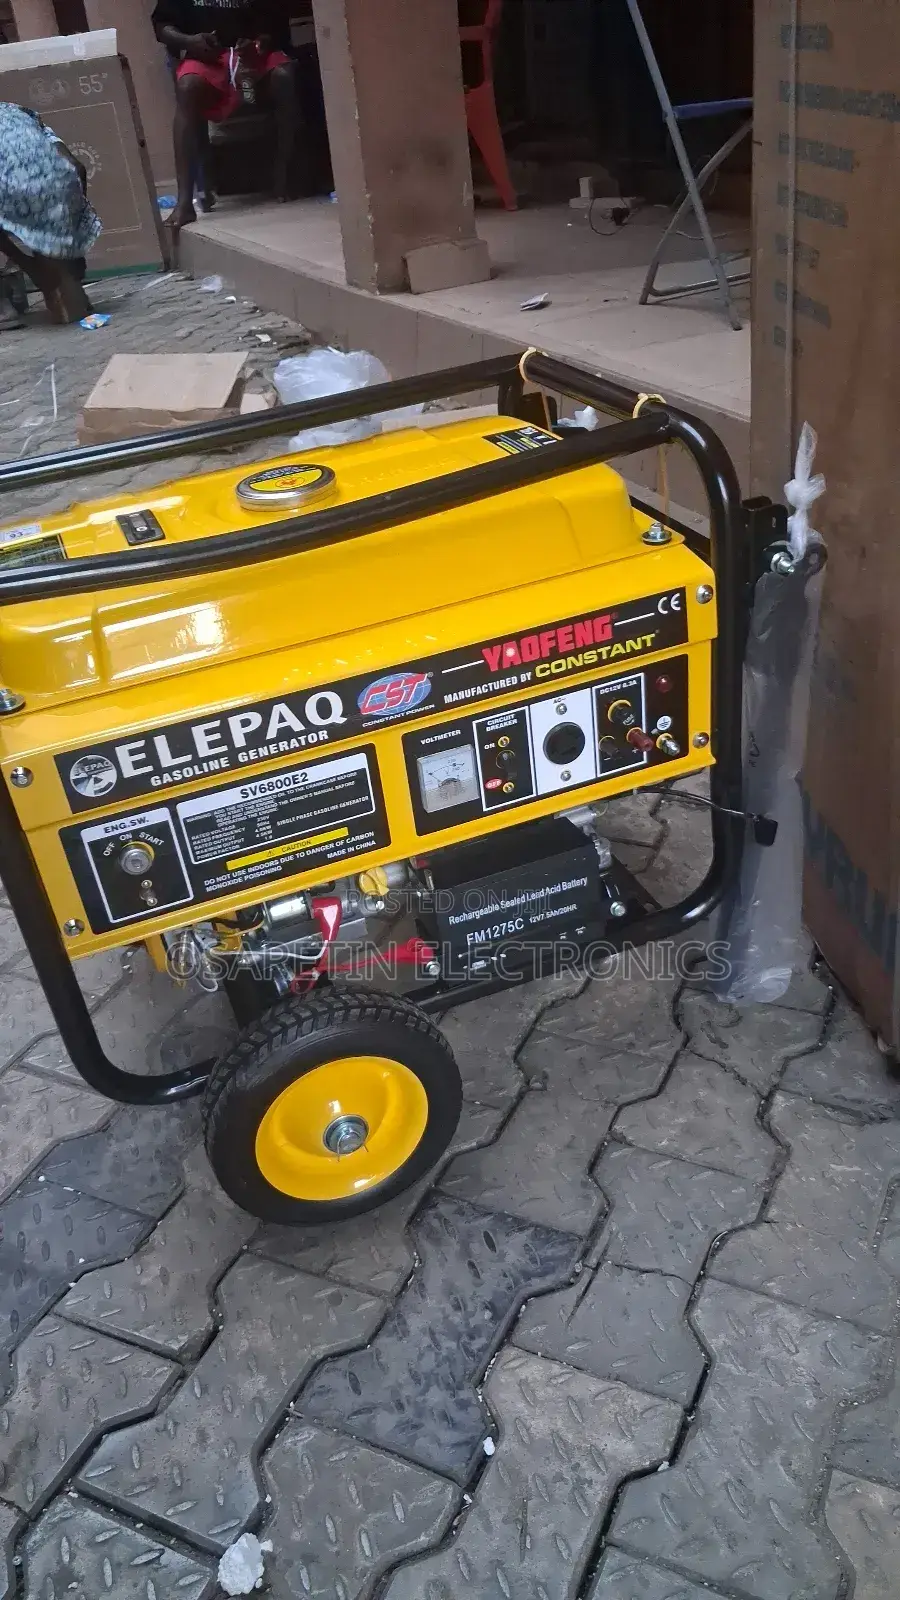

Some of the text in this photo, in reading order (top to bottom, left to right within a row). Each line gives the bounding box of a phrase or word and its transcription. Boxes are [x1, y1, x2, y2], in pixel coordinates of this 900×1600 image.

[481, 615, 613, 672] YAOFENG
[444, 633, 656, 705] MANUFACTURED BY CONSTANT
[361, 673, 427, 714] CST
[600, 684, 621, 695] DC12V
[362, 704, 435, 728] CONSTANT POWER
[487, 714, 515, 726] CIRCUIT
[486, 719, 518, 732] BREAKER
[115, 691, 347, 778] ELEPAQ
[420, 729, 461, 745] VOLTMETER
[484, 742, 496, 750] ON
[150, 730, 329, 787] GASOLINE GENERATOR
[240, 771, 309, 799] SV6800E2
[486, 780, 501, 789] OFF
[296, 812, 313, 820] PHASE
[313, 804, 339, 815] GASOLINE
[339, 796, 369, 808] GENERATOR
[103, 816, 149, 835] ENG.SW.
[191, 832, 210, 840] RATED
[211, 825, 236, 835] VOLTAGE
[119, 832, 133, 841] ON
[138, 831, 165, 846] START
[193, 837, 211, 845] RATED
[194, 842, 213, 850] RATED
[213, 835, 236, 845] OUTPUT
[223, 838, 245, 847] OUTPUT
[103, 842, 116, 857] OFF
[218, 844, 240, 853] FACTOR
[281, 840, 312, 852] CAUTION
[327, 849, 346, 859] MADE
[355, 840, 376, 850] CHINA
[204, 878, 216, 886] DO
[216, 873, 231, 882] NOT
[232, 868, 247, 878] USE
[247, 859, 279, 873] INDOORS
[280, 855, 294, 863] DUE
[295, 851, 305, 859] TO
[306, 843, 335, 856] DANGER
[346, 831, 374, 843] CARBON
[205, 865, 282, 892] MONOXIDE POISONING
[448, 875, 589, 926] Rechargeable Sealed Lead Acid Battery
[465, 917, 526, 945] FM1275C
